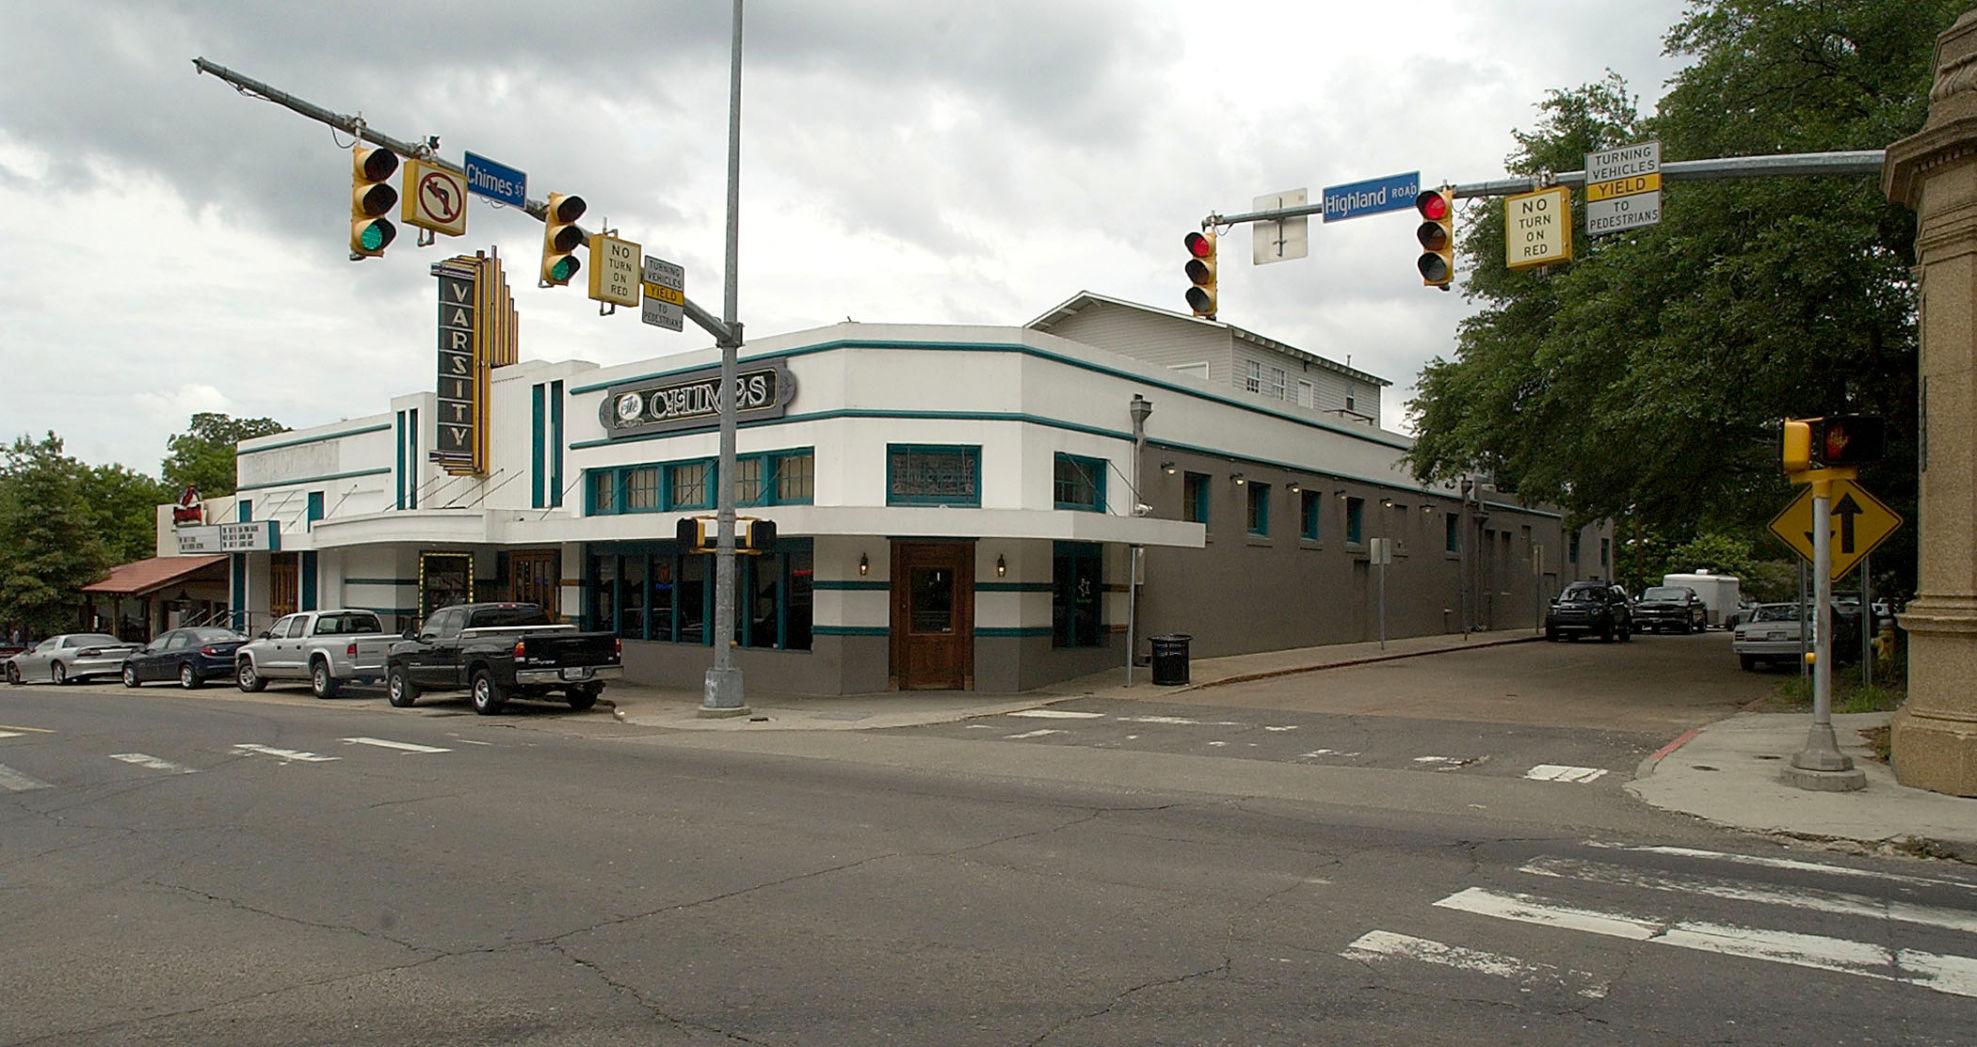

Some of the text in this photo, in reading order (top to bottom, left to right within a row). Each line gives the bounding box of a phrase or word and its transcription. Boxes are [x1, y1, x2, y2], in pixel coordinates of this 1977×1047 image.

[1595, 146, 1651, 166] TURNING
[1592, 160, 1655, 180] VEHICLES
[466, 163, 513, 196] Chimes
[1598, 177, 1646, 197] YIELD
[1325, 184, 1417, 217] Highland ROAD
[1522, 198, 1547, 214] NO
[1613, 200, 1629, 213] TO
[1518, 214, 1552, 229] TURN
[1590, 209, 1658, 230] PEDESTRIANS
[1526, 229, 1544, 242] ON
[611, 244, 630, 259] NO
[1523, 243, 1548, 257] RED
[609, 257, 632, 272] TURN
[649, 259, 681, 278] TURNING
[613, 272, 627, 284] ON
[647, 271, 682, 289] VEHICLES
[610, 284, 628, 297] RED
[650, 284, 677, 302] YIELD
[658, 303, 668, 314] TO
[451, 283, 468, 447] VARSITY
